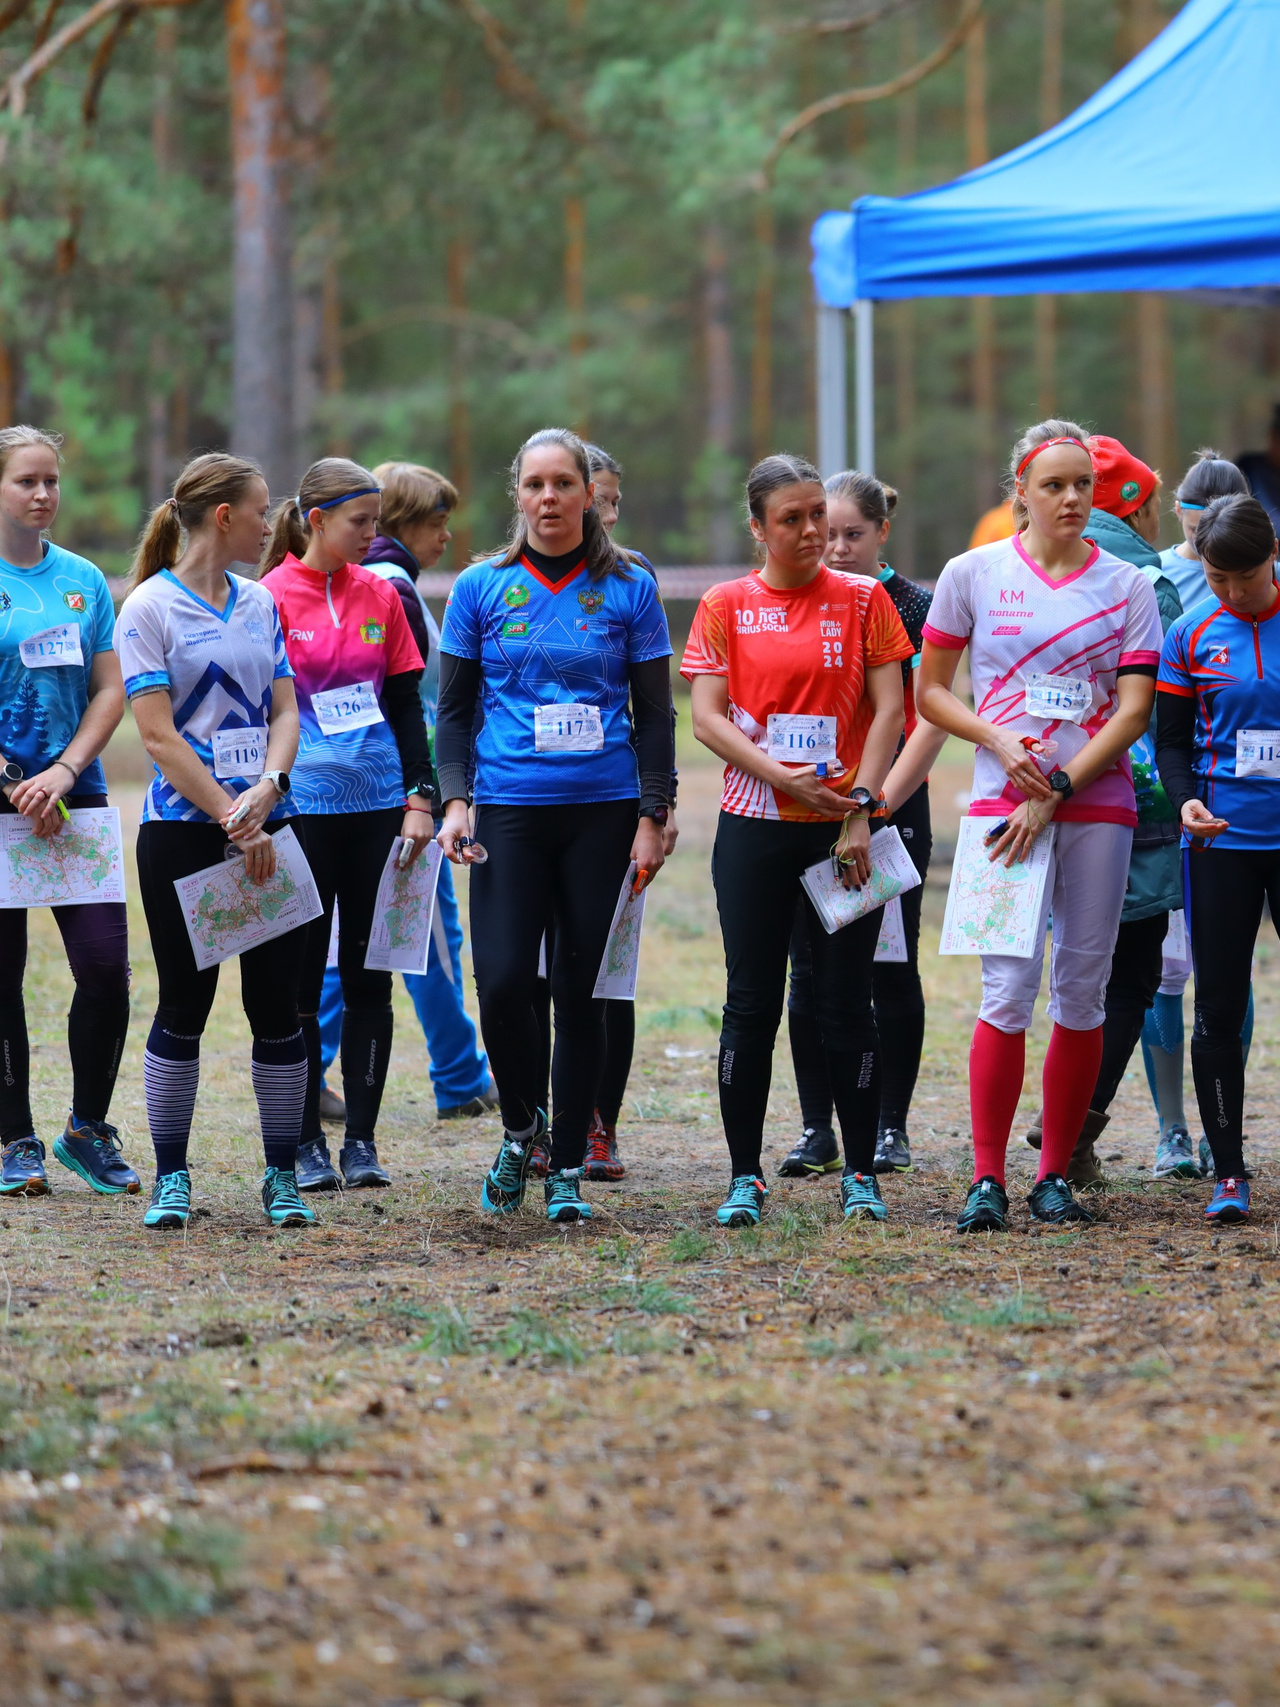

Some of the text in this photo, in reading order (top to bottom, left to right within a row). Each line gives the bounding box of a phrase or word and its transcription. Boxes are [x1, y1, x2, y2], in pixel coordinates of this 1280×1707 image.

[1000, 589, 1025, 604] KM
[735, 609, 787, 625] 10 лет
[988, 610, 1034, 618] noname
[736, 622, 788, 635] SIRIUS SOCHI
[820, 620, 835, 628] IRON
[821, 627, 842, 637] LADY
[38, 641, 64, 655] 127
[1046, 691, 1072, 708] 115
[334, 701, 361, 717] 126
[558, 720, 583, 735] 117
[789, 733, 816, 749] 116
[235, 747, 259, 763] 119
[369, 1039, 377, 1074] NORD
[1215, 1078, 1225, 1115] NORD
